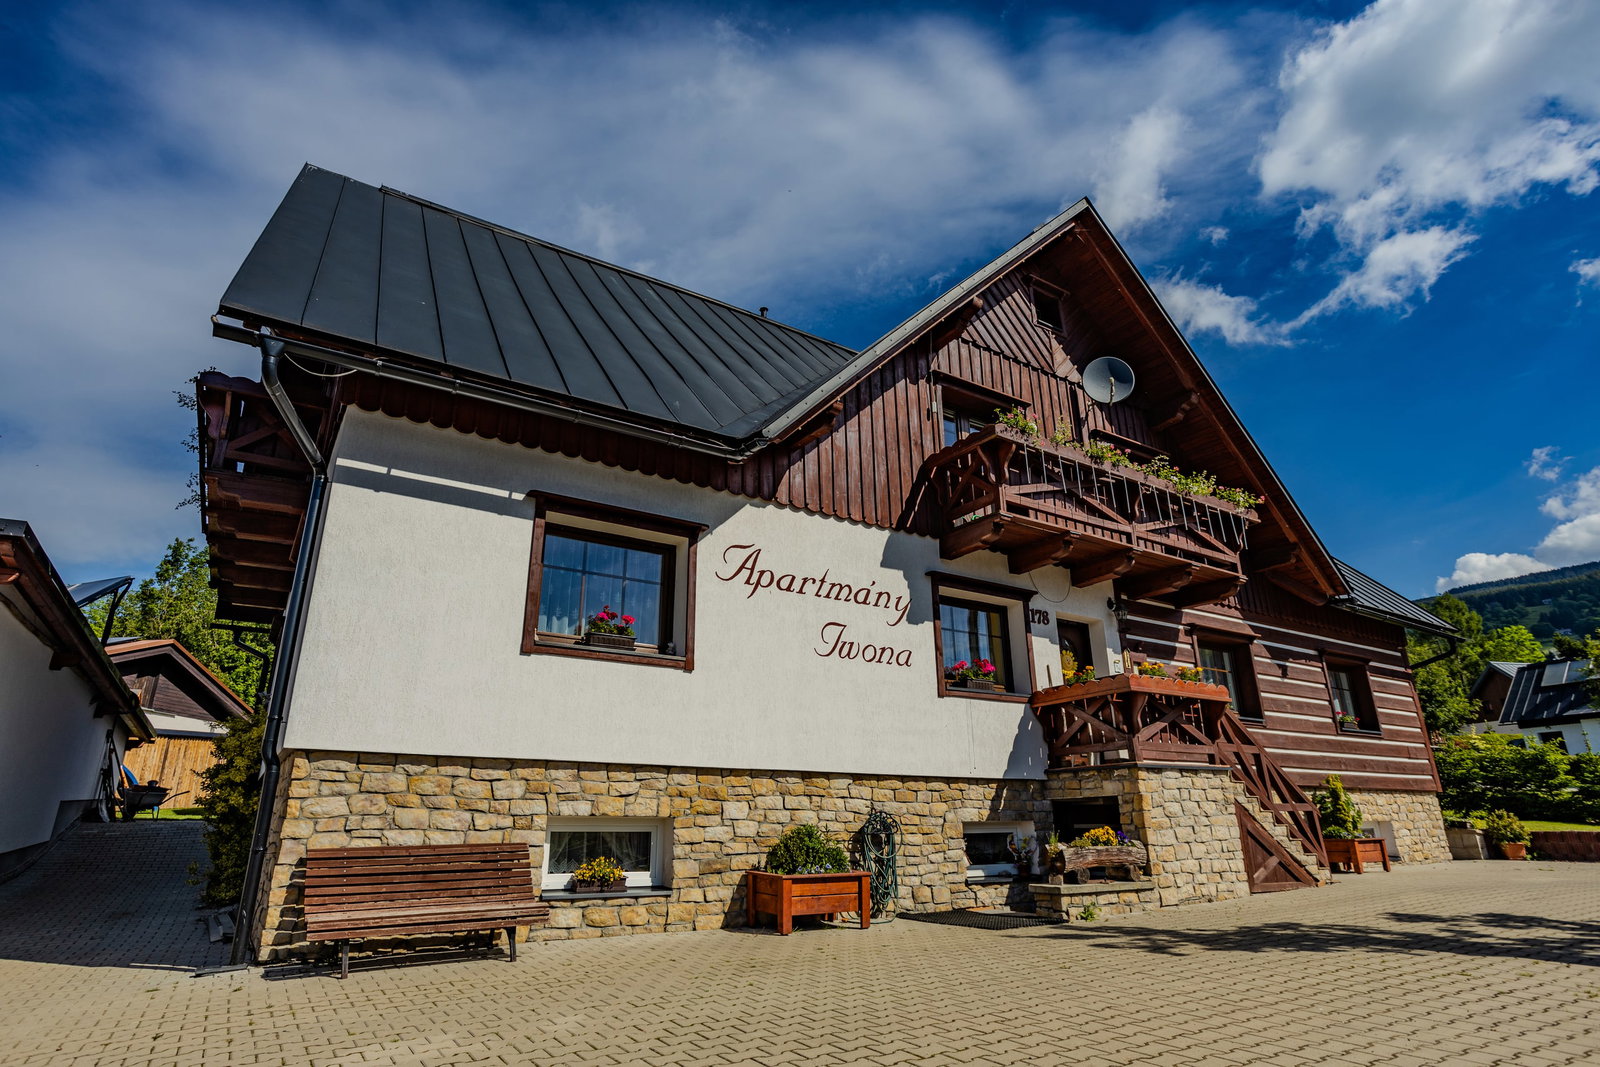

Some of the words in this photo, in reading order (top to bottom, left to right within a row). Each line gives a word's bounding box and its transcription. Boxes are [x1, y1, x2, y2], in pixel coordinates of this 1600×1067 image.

[714, 543, 912, 627] Apartmány
[1029, 608, 1050, 626] 178
[813, 621, 912, 668] Iwona
